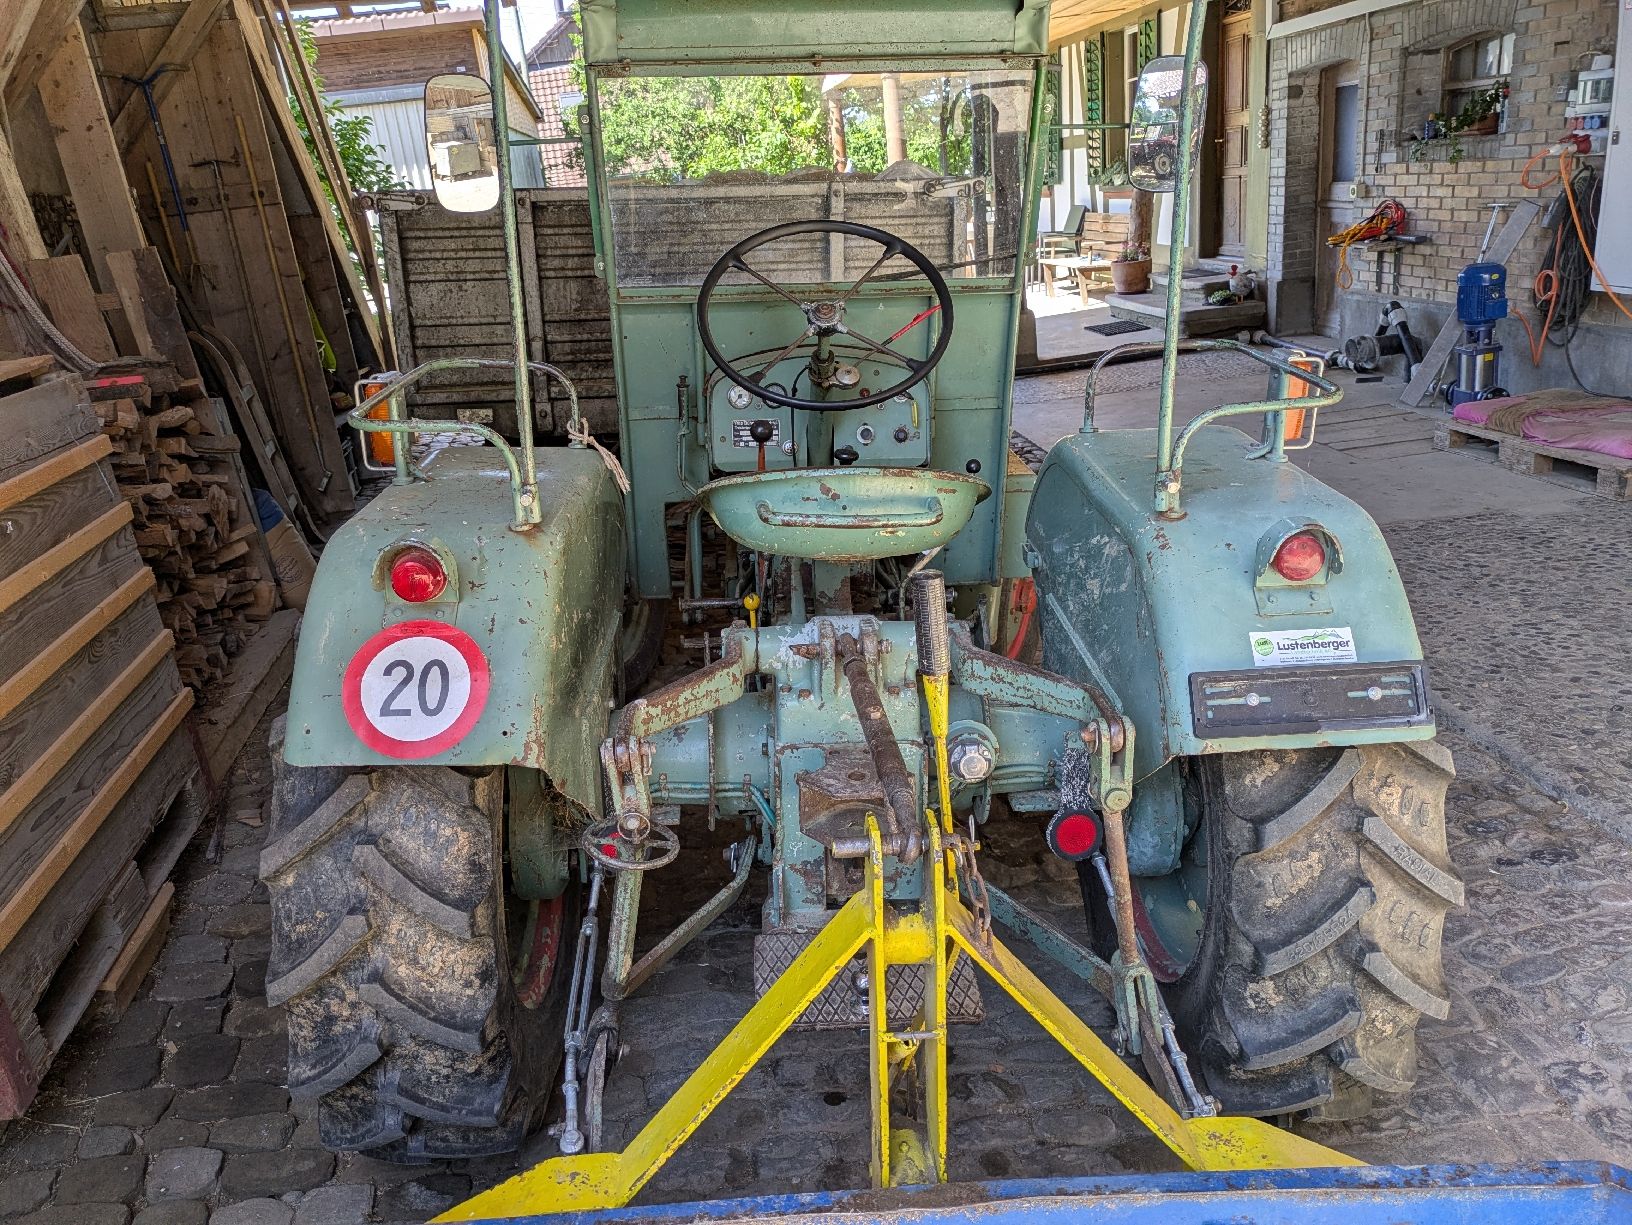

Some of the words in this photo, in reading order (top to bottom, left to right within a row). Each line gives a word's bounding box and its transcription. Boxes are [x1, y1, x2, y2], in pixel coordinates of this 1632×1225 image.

[1277, 640, 1350, 650] Lustenberger
[379, 658, 450, 717] 20
[1393, 845, 1440, 887] RADIAL
